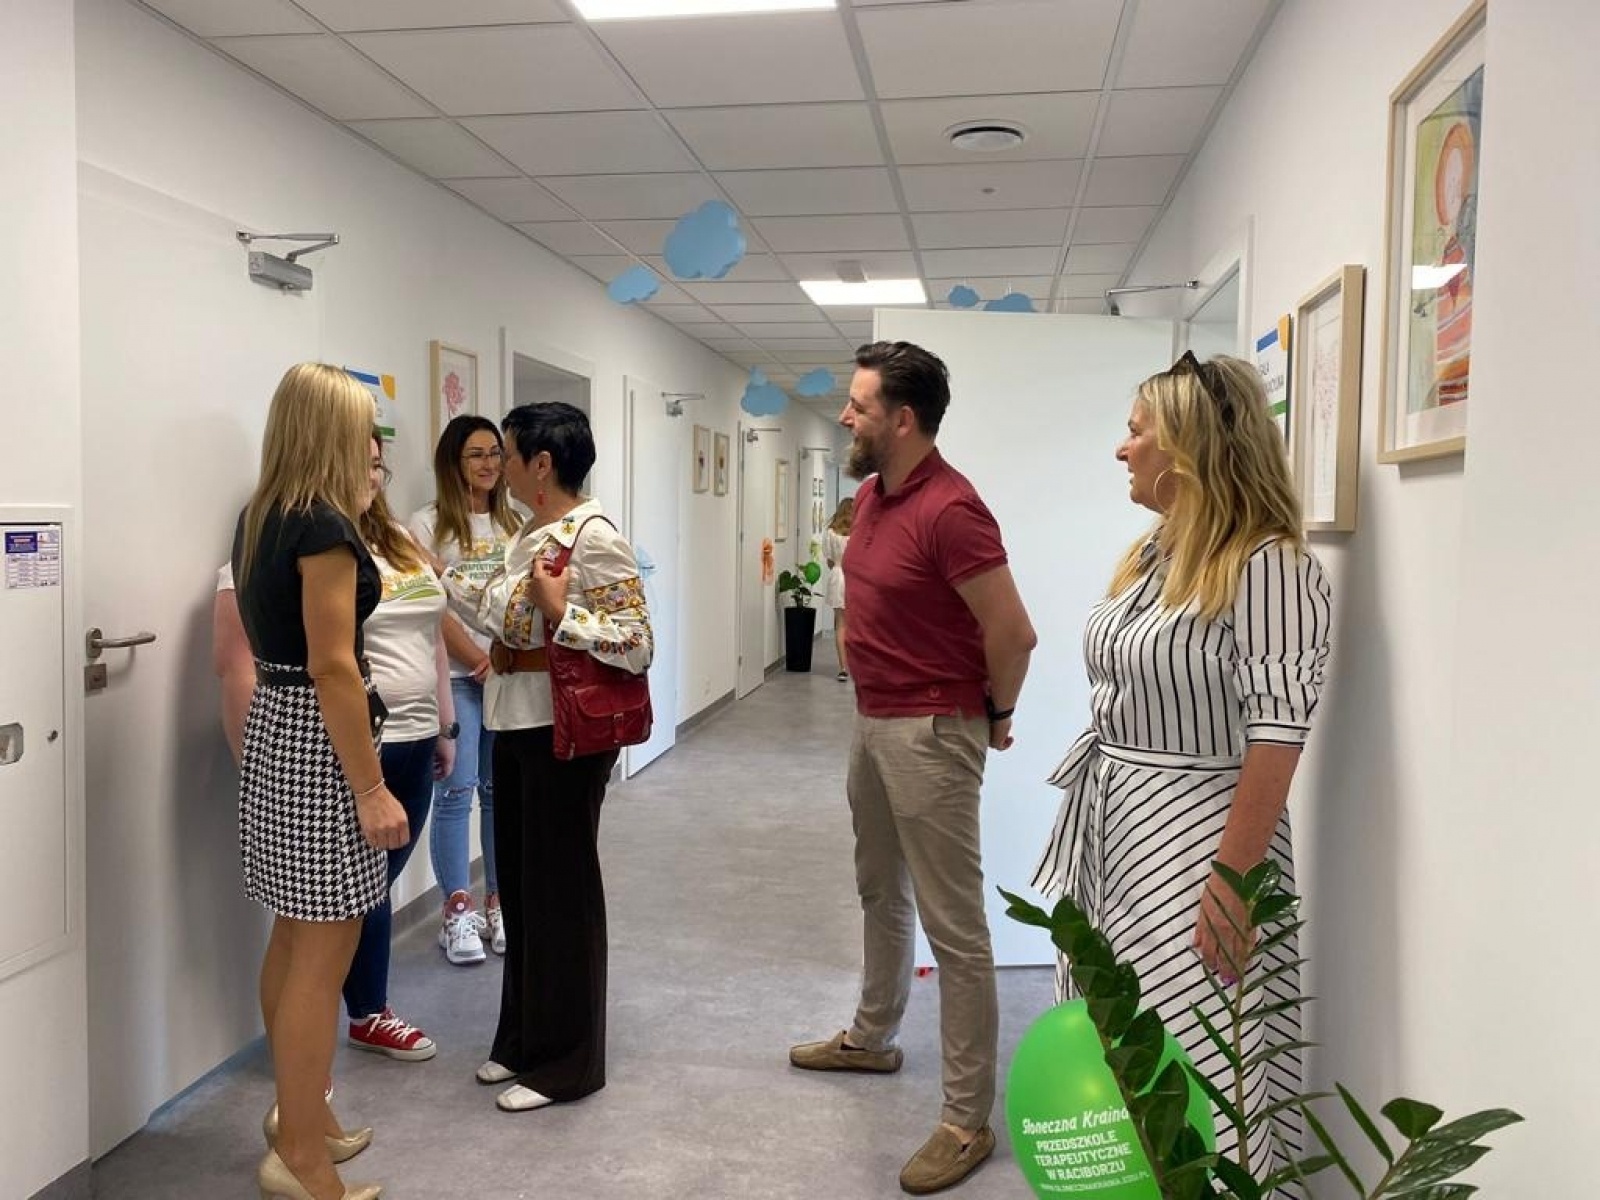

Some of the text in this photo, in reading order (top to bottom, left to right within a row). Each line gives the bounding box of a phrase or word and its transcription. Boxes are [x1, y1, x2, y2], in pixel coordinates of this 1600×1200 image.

[1082, 1105, 1129, 1128] Kraina
[1036, 1130, 1118, 1152] PRZEDSZKOLE
[1034, 1142, 1132, 1166] TERAPEUTYCZNE
[1046, 1159, 1126, 1180] W RACIBORZU
